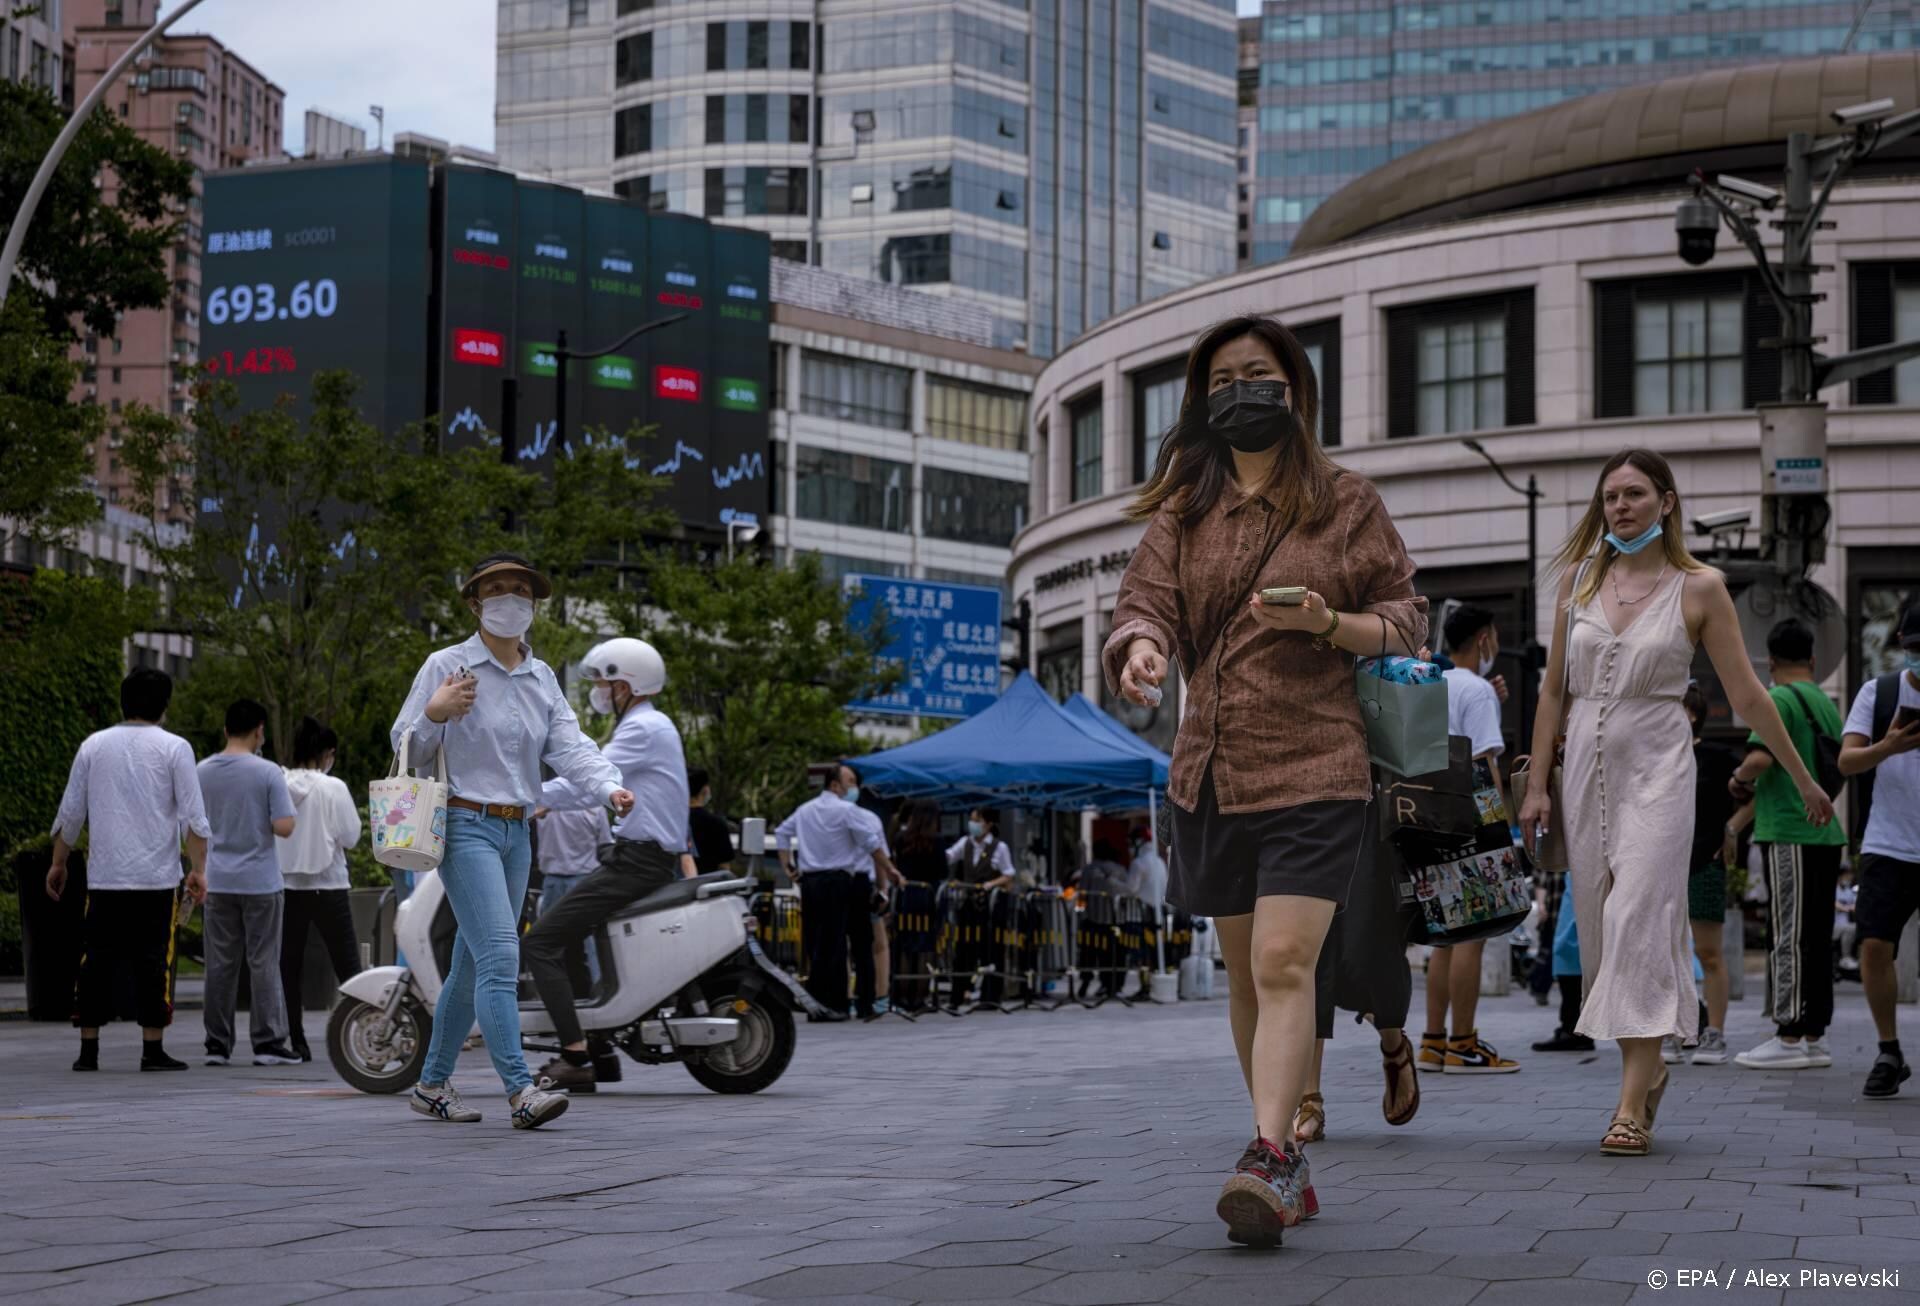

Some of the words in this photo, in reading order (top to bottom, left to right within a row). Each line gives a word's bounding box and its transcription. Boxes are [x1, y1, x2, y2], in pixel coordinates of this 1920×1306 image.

[207, 229, 272, 254] 原油连续
[285, 226, 337, 247] sc0001
[206, 278, 338, 325] 693.60
[207, 346, 297, 376] +1.42%
[886, 586, 954, 610] 北京西路
[943, 621, 996, 643] 成都北路
[942, 661, 995, 683] 成都北路
[1396, 796, 1417, 824] R
